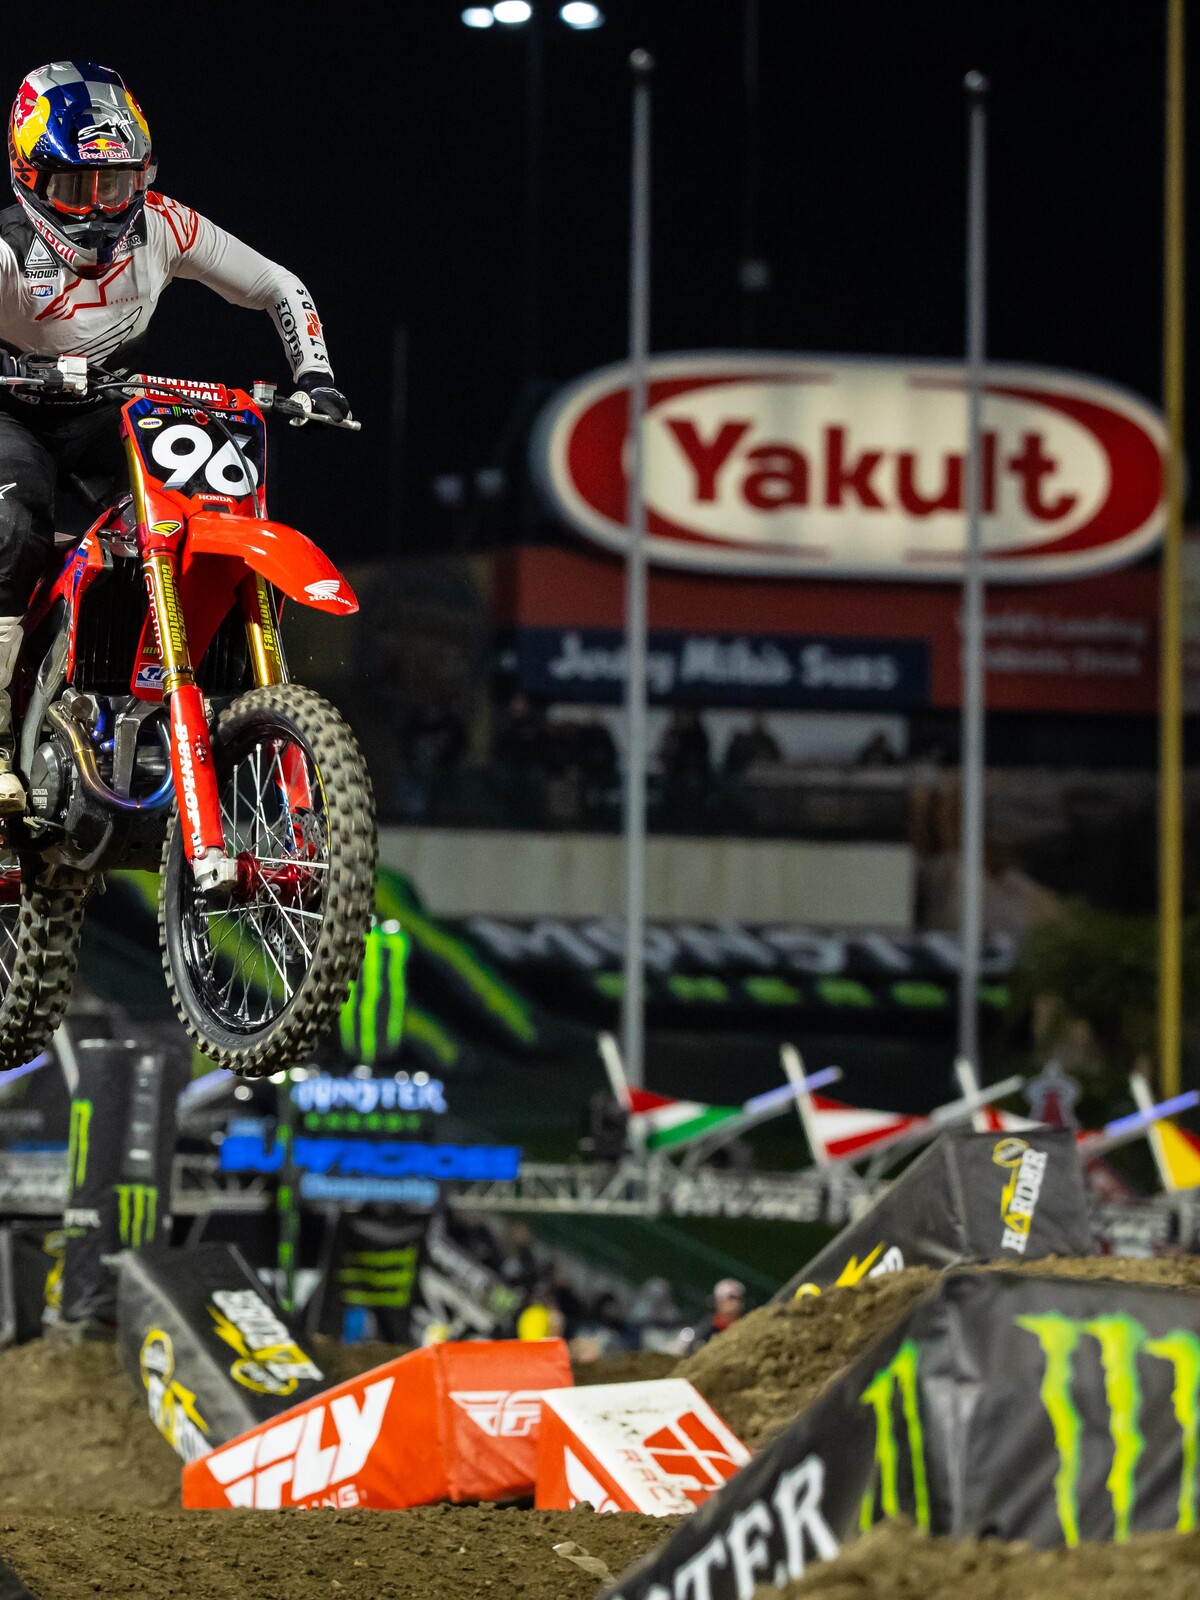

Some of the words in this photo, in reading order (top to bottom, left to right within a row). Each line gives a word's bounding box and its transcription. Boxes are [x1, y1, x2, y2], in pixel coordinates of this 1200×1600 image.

[79, 149, 106, 160] Red
[107, 150, 131, 159] Bull
[24, 269, 59, 279] SHOWA
[31, 286, 52, 296] 100%
[147, 375, 221, 391] RENTHAL
[151, 424, 259, 496] 96
[660, 417, 1081, 526] Yakult
[198, 494, 233, 503] HONDA
[309, 595, 353, 607] HONDA
[174, 723, 201, 826] DUNLOP
[205, 1376, 395, 1511] FLY
